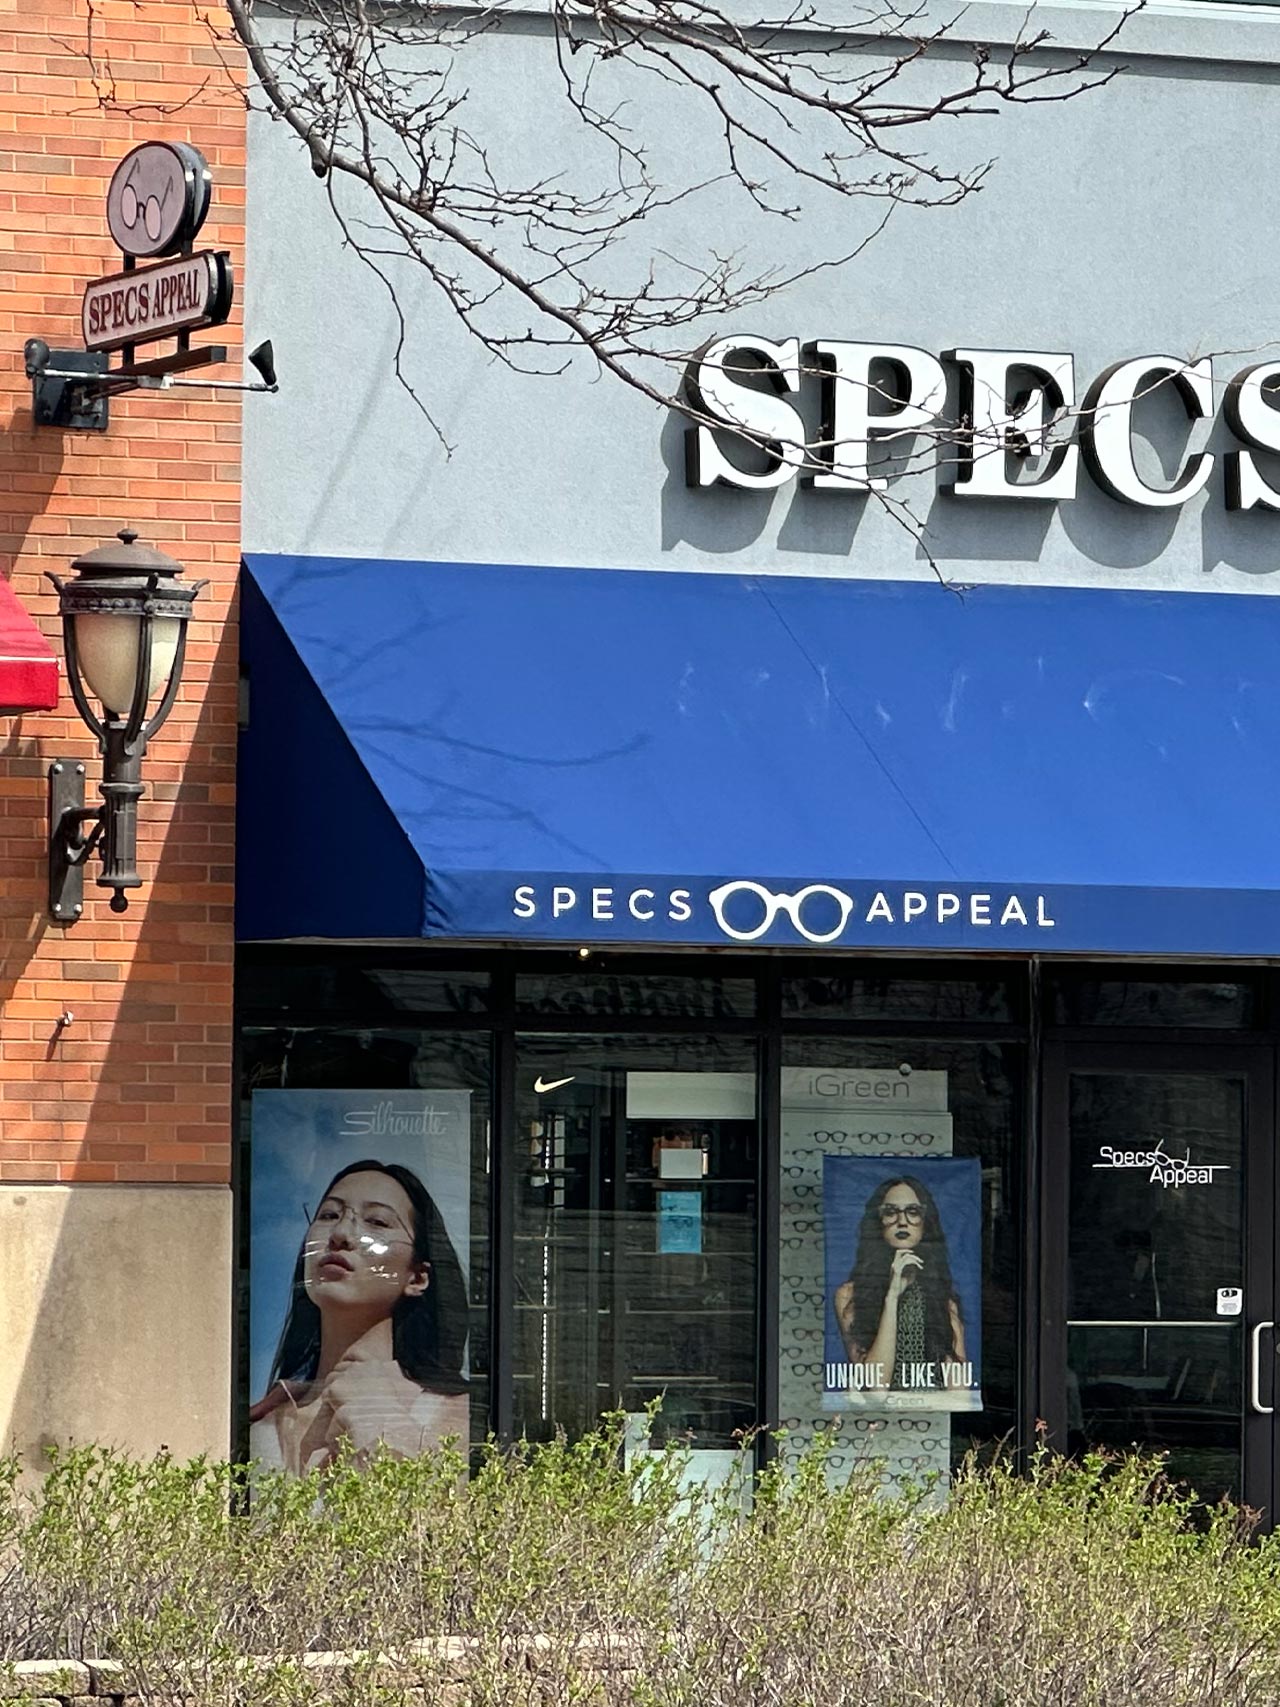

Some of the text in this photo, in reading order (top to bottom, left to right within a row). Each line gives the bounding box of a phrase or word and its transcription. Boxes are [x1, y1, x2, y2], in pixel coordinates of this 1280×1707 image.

[89, 269, 201, 334] SPECS APPEAL
[513, 886, 1056, 927] SPECS APPEAL
[808, 1073, 911, 1099] iGreen
[338, 1100, 449, 1136] Silhouette
[1099, 1145, 1156, 1168] Specs
[1149, 1164, 1213, 1189] Appeal
[825, 1360, 979, 1391] UNIQUE. LIKE YOU.
